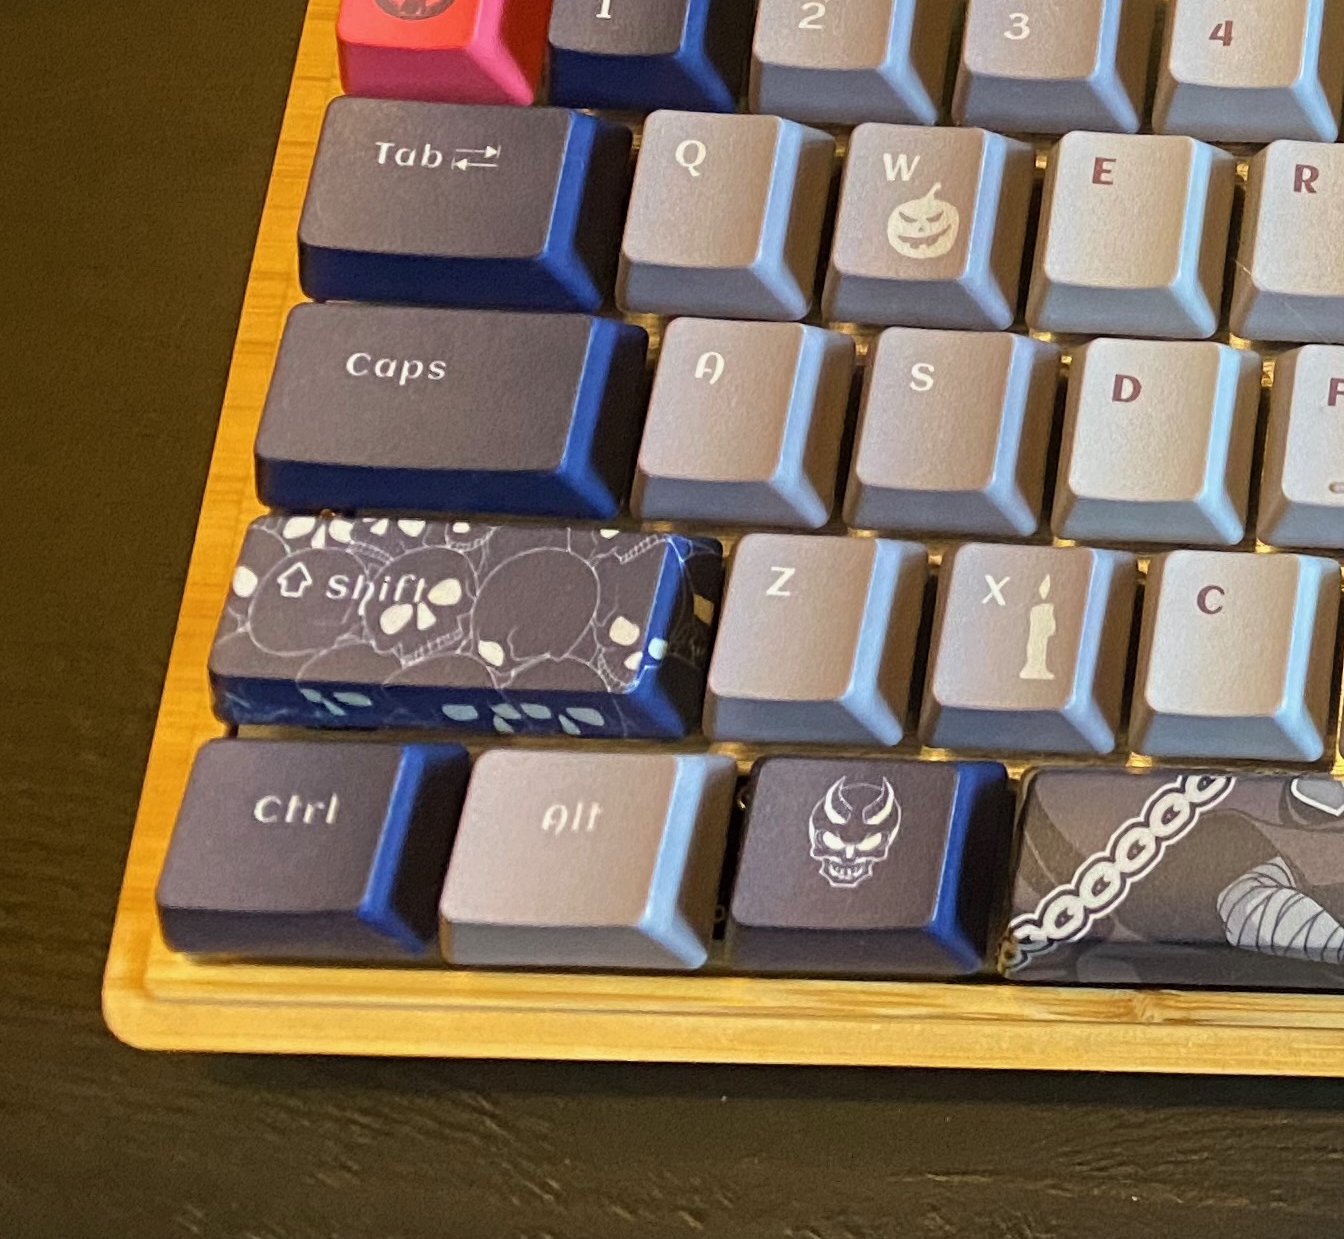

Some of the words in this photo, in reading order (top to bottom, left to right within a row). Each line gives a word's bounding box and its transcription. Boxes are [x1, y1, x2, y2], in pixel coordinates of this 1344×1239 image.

[797, 1, 826, 30] 2
[1003, 12, 1031, 40] 3
[1208, 20, 1234, 47] 4
[375, 141, 443, 168] Tab
[675, 139, 707, 177] Q
[882, 152, 921, 182] W
[1091, 156, 1117, 186] E
[1293, 163, 1320, 194] R
[346, 352, 447, 386] Caps
[694, 351, 725, 385] A
[909, 362, 935, 392] S
[1111, 373, 1142, 403] D
[325, 573, 427, 616] Shift
[765, 566, 796, 597] Z
[981, 574, 1011, 606] X
[1196, 585, 1225, 615] C
[253, 795, 338, 824] Ctrl
[541, 800, 603, 836] Alt
